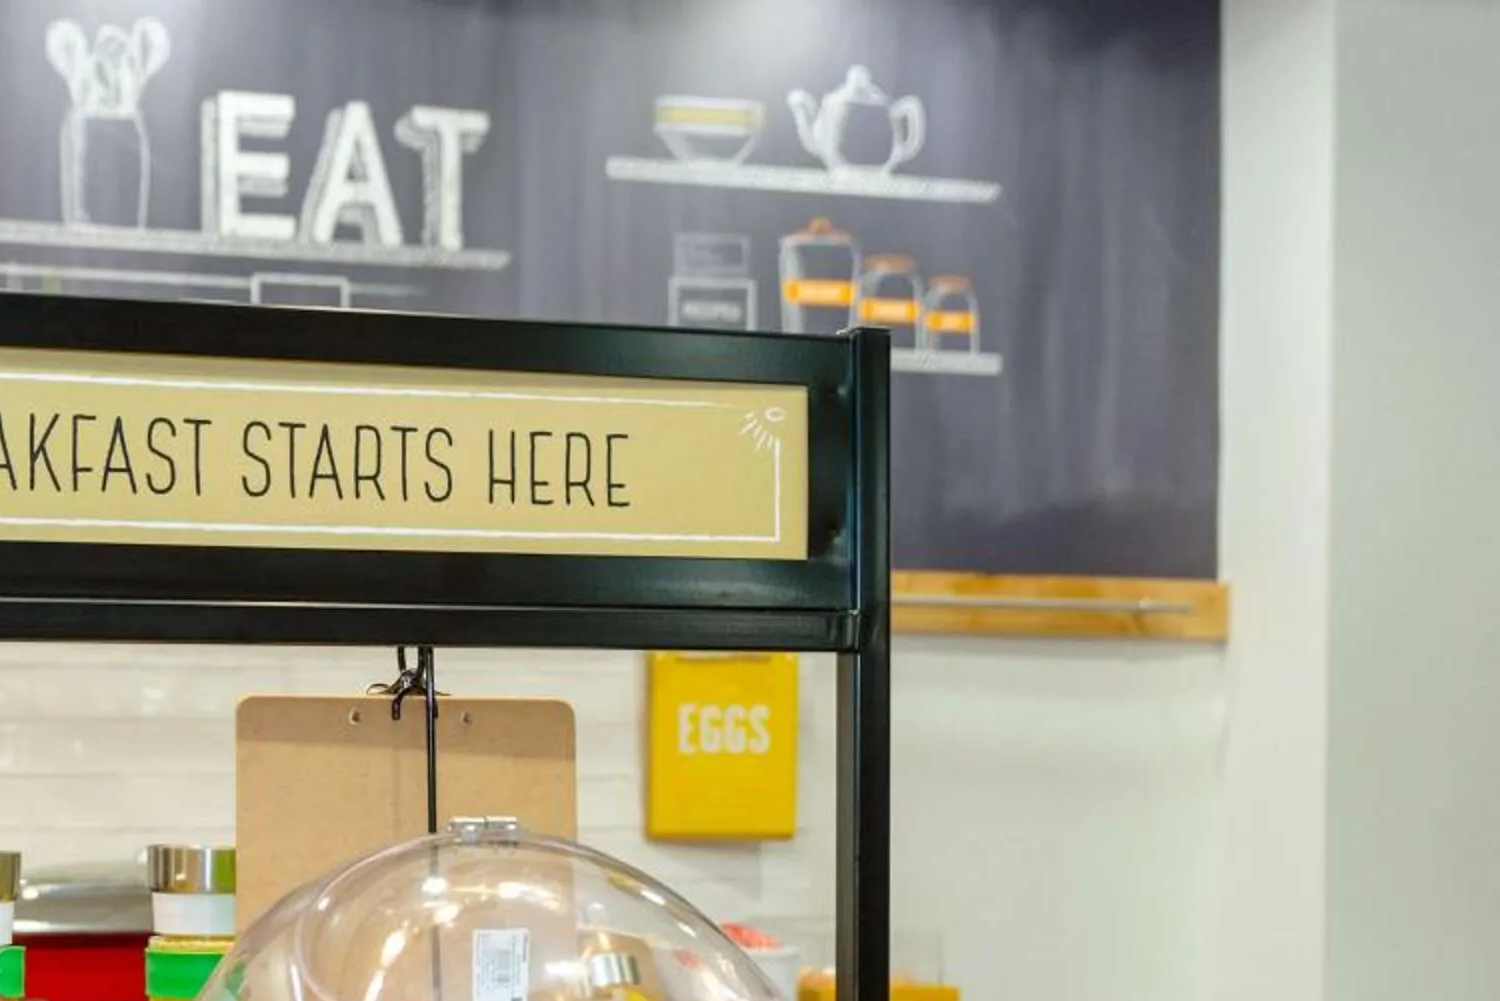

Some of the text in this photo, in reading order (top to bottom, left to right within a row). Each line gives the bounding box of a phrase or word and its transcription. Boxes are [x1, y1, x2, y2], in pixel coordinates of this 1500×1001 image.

[200, 90, 490, 250] EAT
[241, 419, 453, 503] STARTS
[488, 428, 631, 508] HERE
[677, 703, 771, 755] EGGS
